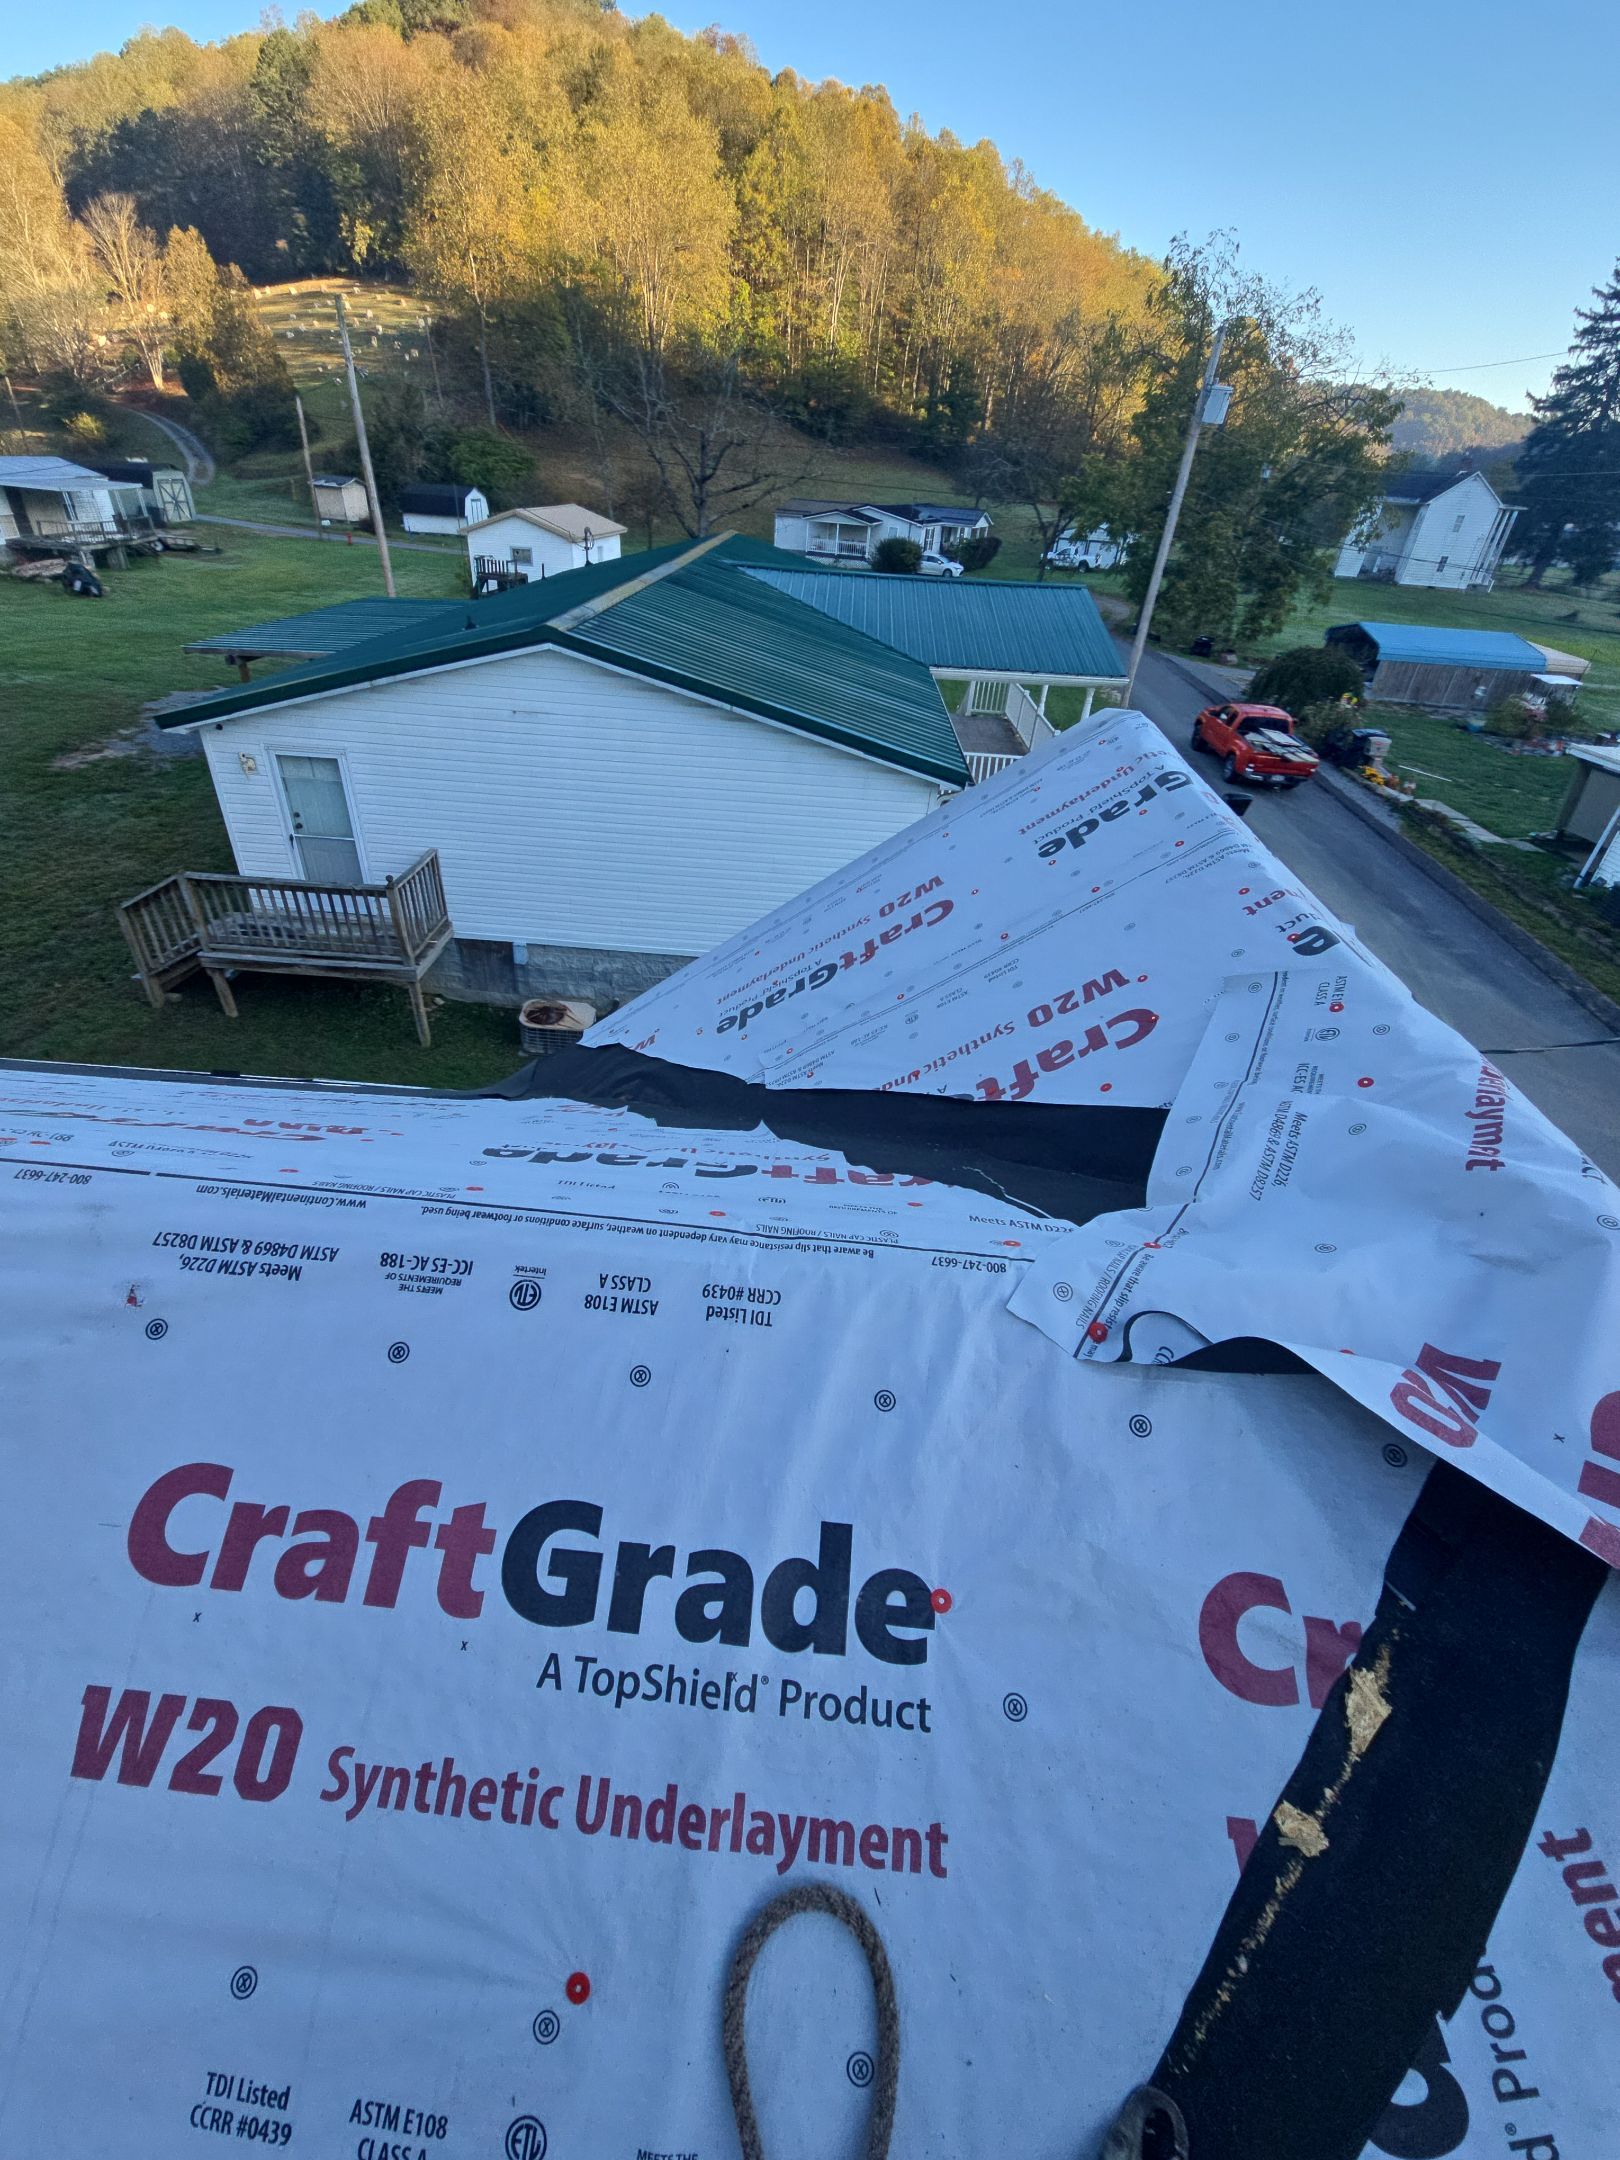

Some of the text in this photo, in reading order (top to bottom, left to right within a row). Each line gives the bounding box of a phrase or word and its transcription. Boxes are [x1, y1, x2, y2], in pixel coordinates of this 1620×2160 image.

[1019, 766, 1134, 834] Underlayment
[1034, 814, 1083, 844] Product
[862, 875, 946, 926] W20
[809, 915, 870, 953] Synthetic
[716, 899, 954, 1035] CraftGrade
[717, 952, 805, 1004] Underlayment
[720, 994, 757, 1017] Product
[923, 968, 1131, 1073] W20 Synthetic
[1288, 1112, 1307, 1139] Meets
[1259, 1144, 1276, 1172] ASTM
[1281, 1139, 1299, 1164] ASTM
[14, 1168, 92, 1185] 800-247-6637
[1249, 1170, 1269, 1201] D8257
[1271, 1163, 1292, 1187] D226,
[196, 1184, 367, 1208] www.ContinentalMaterials.com
[421, 1206, 874, 1258] Be aware that slip resistance may vary dependent on weather, surface conditions or footwear being used.
[756, 1224, 780, 1234] NAILS
[781, 1226, 816, 1236] ROOFING
[969, 1215, 1006, 1226] Meets
[1009, 1219, 1042, 1231] ASTM
[152, 1232, 340, 1262] ASTM D4869 & ASTM D8257
[824, 1231, 847, 1240] NAILS
[179, 1254, 302, 1282] Meets ASTM D226,
[380, 1252, 474, 1276] ICC-ES AC-188
[514, 1264, 546, 1276] Intertek
[931, 1256, 1007, 1273] 800-247-6637
[398, 1273, 462, 1286] REQUIREMENTS
[398, 1284, 444, 1295] MEETS THE
[600, 1274, 652, 1293] CLASS A
[1123, 1276, 1139, 1293] that
[702, 1284, 782, 1306] CCRR #0439
[1087, 1277, 1111, 1308] ROOFING
[1115, 1292, 1129, 1307] slip
[584, 1294, 658, 1316] ASTM E108
[706, 1306, 773, 1327] TDI Listed
[1076, 1306, 1094, 1329] NAILS
[1083, 1345, 1098, 1358] may
[126, 1461, 938, 1667] CraftGrade
[536, 1652, 564, 1691] A
[778, 1680, 933, 1735] Product
[70, 1684, 950, 1879] W20 Synthetic Underlayment
[206, 2072, 292, 2111] TDI Listed
[190, 2104, 292, 2147] CCRR #0439
[349, 2098, 448, 2140] ASTM E108
